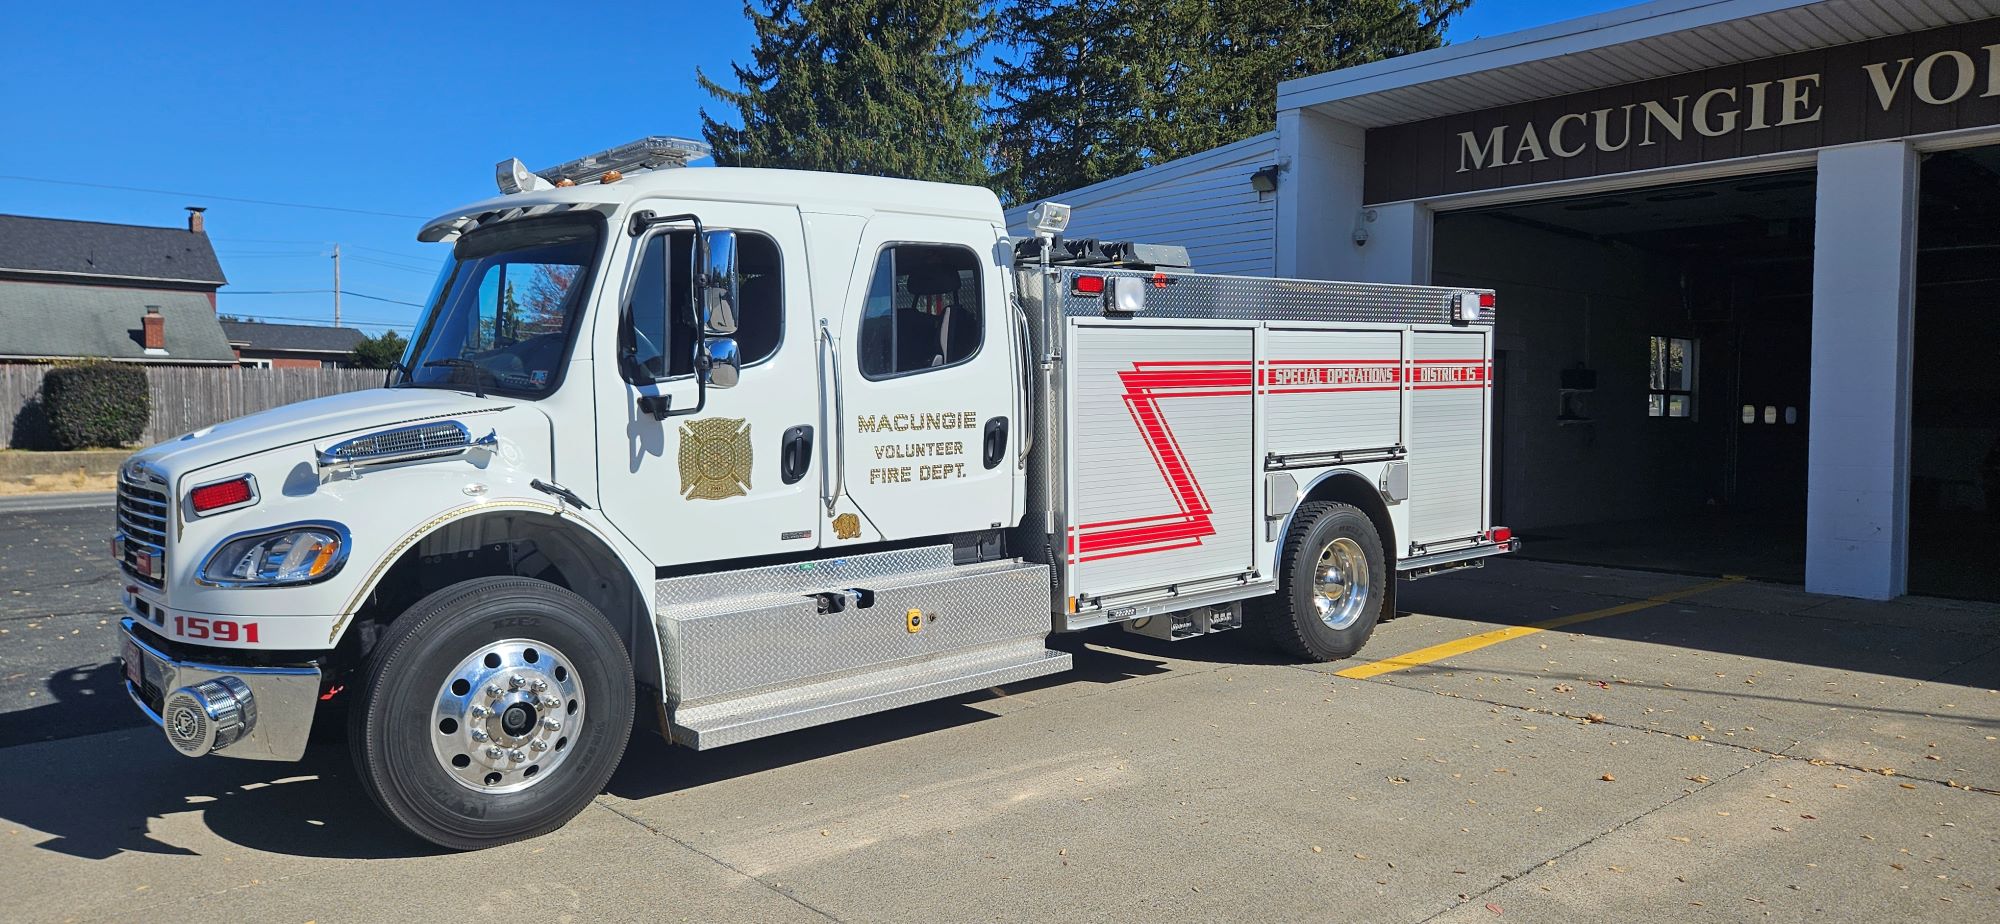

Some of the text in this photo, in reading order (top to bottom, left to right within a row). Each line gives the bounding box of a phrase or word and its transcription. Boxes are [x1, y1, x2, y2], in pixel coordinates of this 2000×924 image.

[1456, 73, 1823, 173] MACUNGIE
[1276, 367, 1393, 384] SPECIAL OPERATIONS
[1421, 367, 1476, 382] DISTRICT 15
[858, 411, 977, 433] MACUNGIE
[874, 441, 963, 459] VOLUNTEER
[870, 463, 966, 484] FIRE DEPT.
[174, 616, 259, 643] 1591
